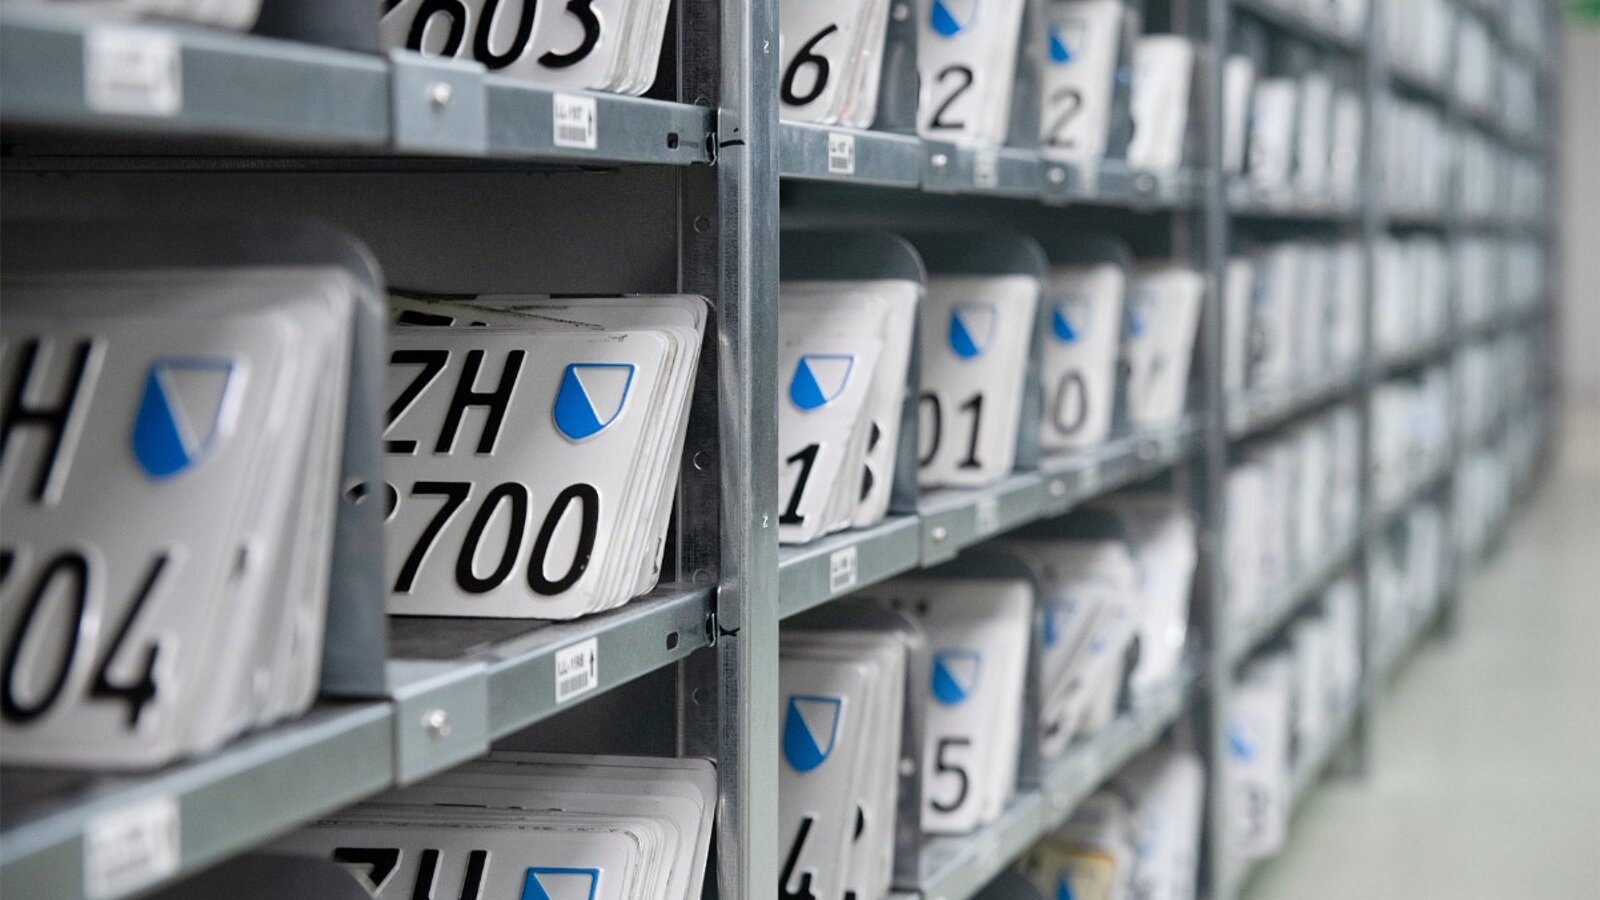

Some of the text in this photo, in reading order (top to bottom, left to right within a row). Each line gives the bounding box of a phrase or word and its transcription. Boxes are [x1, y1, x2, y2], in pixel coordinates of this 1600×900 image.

[383, 0, 600, 70] 603
[780, 23, 838, 106] 6
[929, 65, 974, 130] 2
[387, 350, 526, 453] ZH
[779, 443, 820, 525] 1
[0, 546, 169, 730] 04
[930, 737, 973, 813] 5
